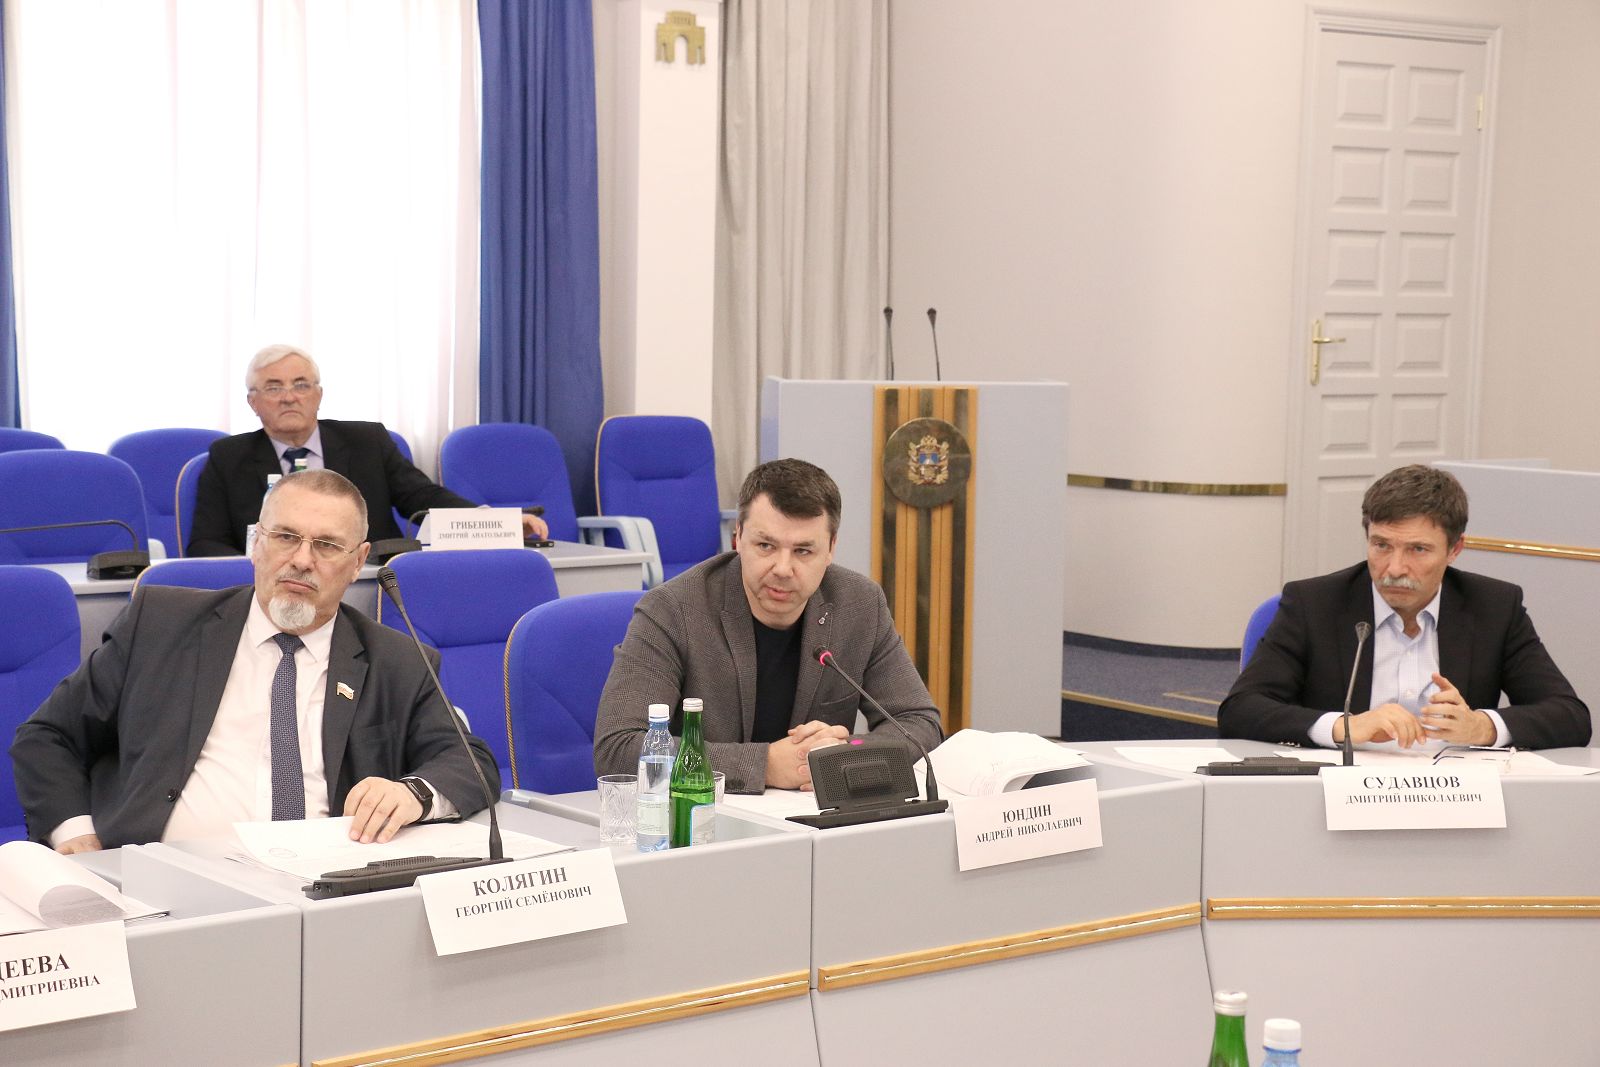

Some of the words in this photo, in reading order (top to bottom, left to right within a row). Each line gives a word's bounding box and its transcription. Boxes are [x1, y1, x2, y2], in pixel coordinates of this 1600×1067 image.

[450, 520, 503, 530] ГРИБЕННИК
[1363, 776, 1461, 790] СУДАВЦОВ
[1345, 793, 1401, 805] ДМИТРИЙ
[1404, 793, 1483, 803] НИКОЛАЕВИЧ
[1002, 804, 1052, 824] ЮНДИН
[975, 826, 1014, 844] АНДРЕЙ
[1017, 816, 1083, 837] НИКОЛАЕВИЧ
[472, 866, 568, 897] КОЛЯГИН
[455, 898, 514, 918] ГЕОРГИЙ
[515, 885, 593, 908] СЕМЁНОВИЧ
[0, 953, 71, 983] ЕЕВА
[0, 974, 101, 1001] МИТРИЕВНА
